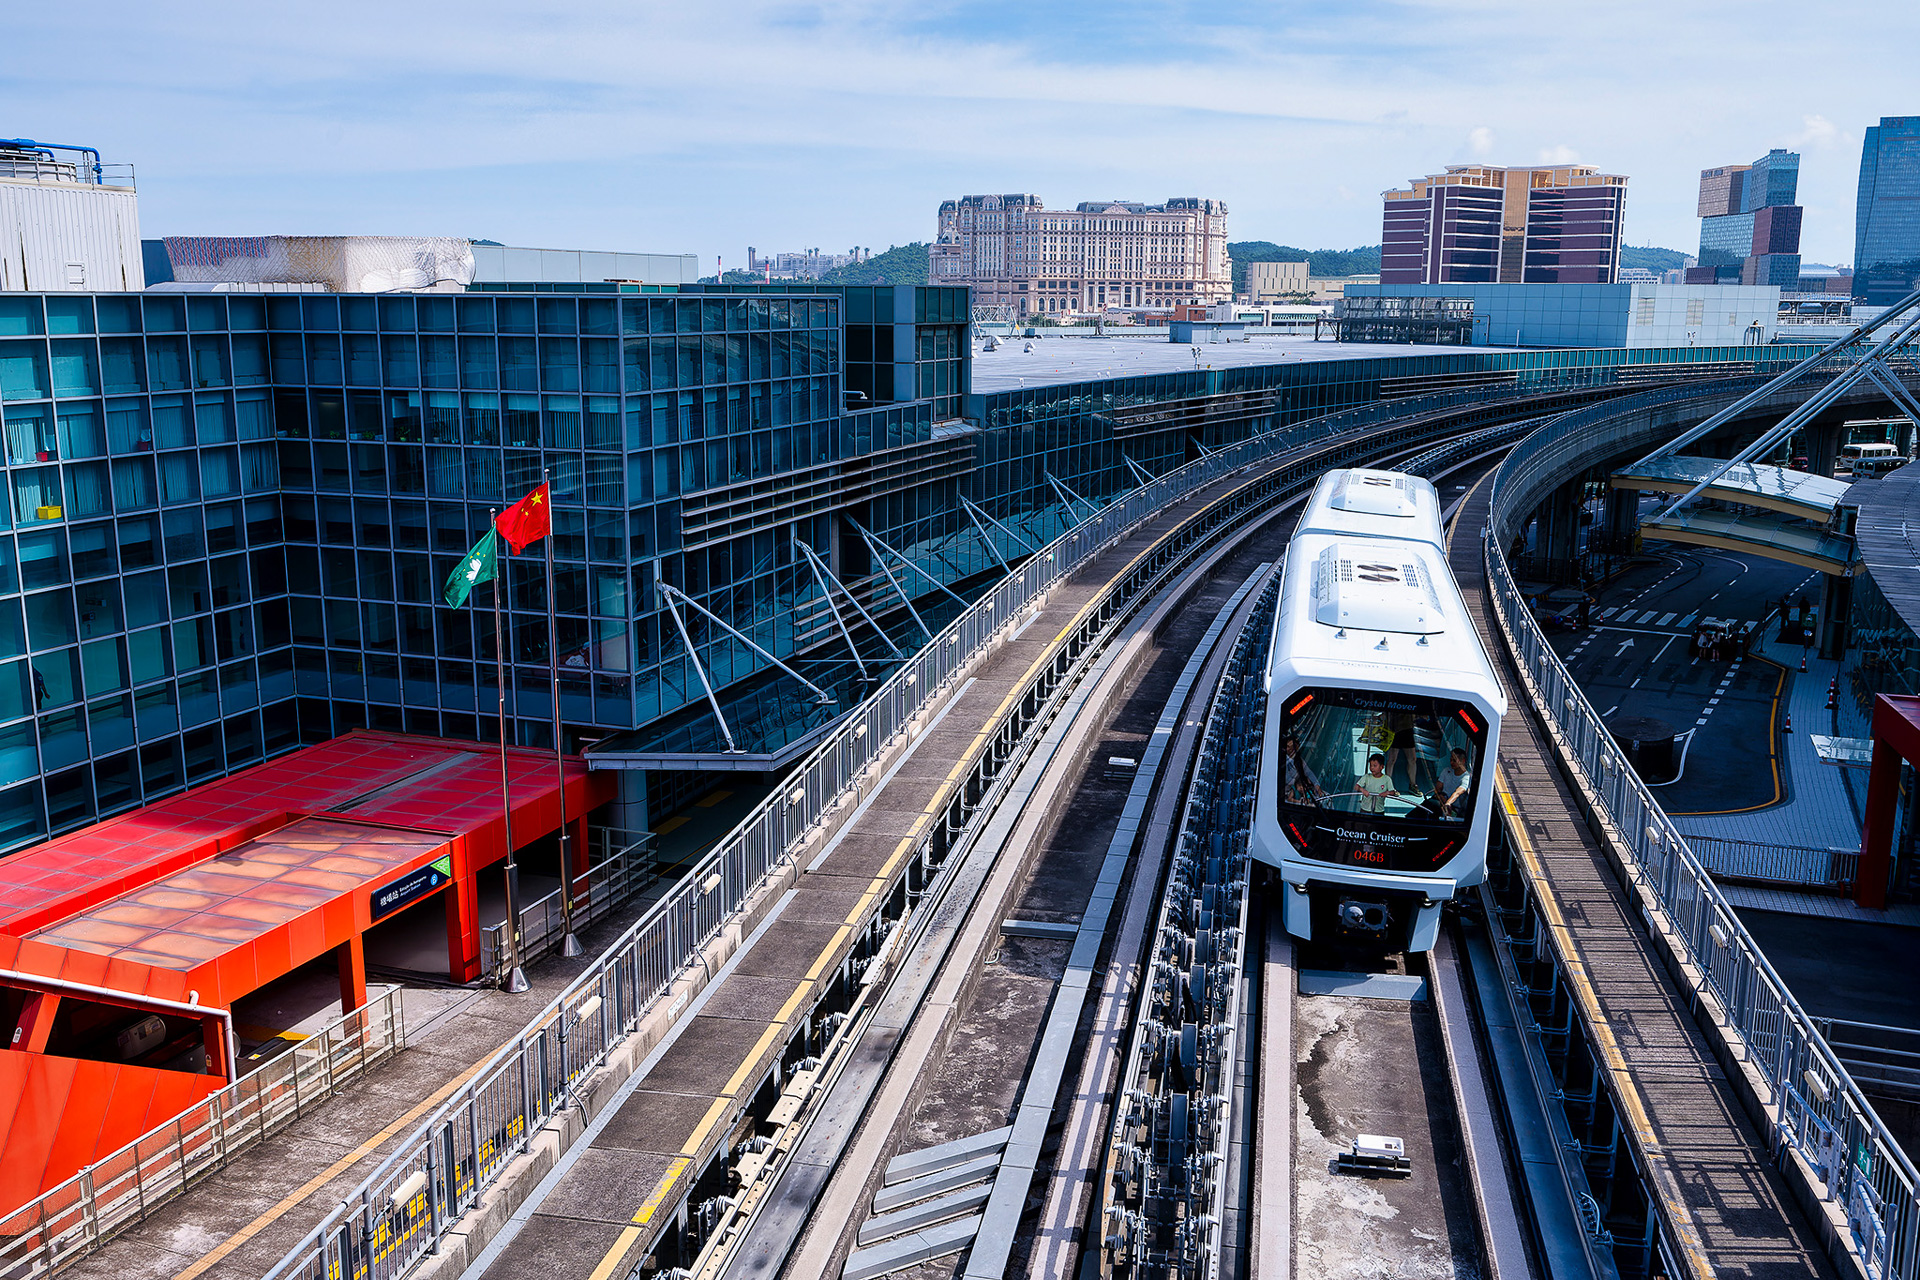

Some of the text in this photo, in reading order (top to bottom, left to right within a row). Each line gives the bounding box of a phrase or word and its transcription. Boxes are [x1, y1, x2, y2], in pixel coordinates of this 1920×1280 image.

[1354, 697, 1417, 711] Crystal Mover
[1336, 827, 1366, 839] Ocean
[1369, 831, 1406, 843] Cruiser
[1354, 849, 1384, 863] 046B
